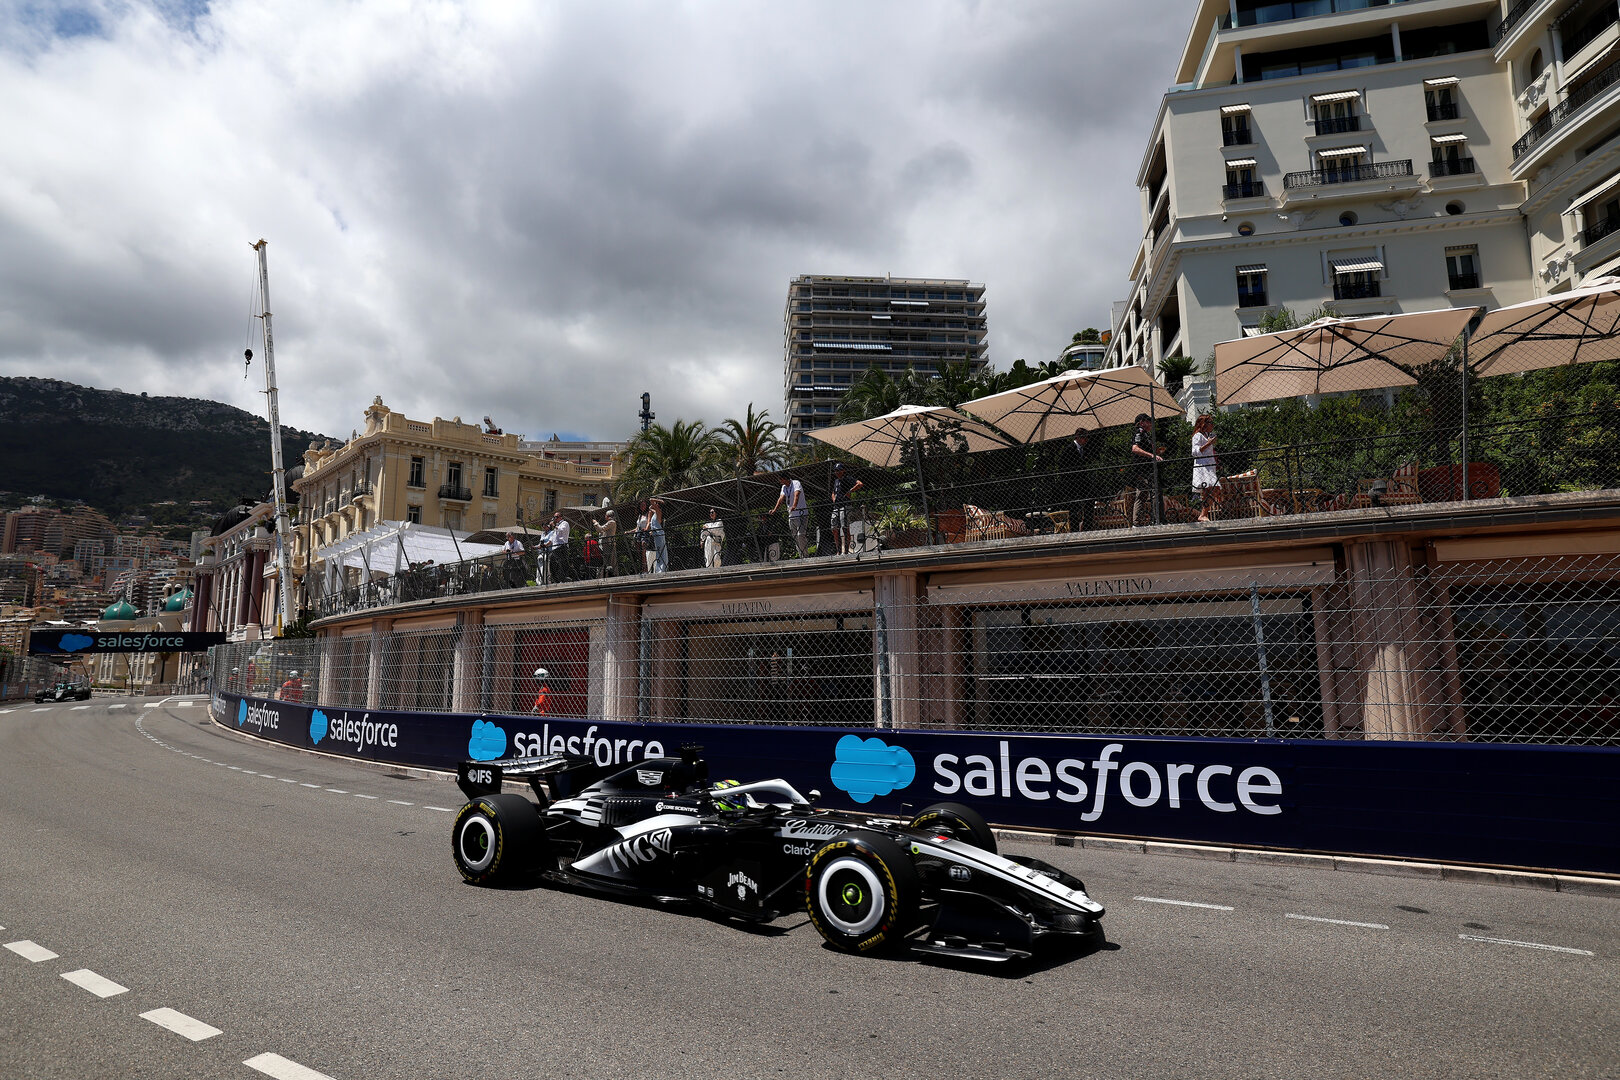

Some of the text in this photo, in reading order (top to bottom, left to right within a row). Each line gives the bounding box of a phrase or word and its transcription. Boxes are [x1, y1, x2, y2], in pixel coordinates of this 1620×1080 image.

[1066, 578, 1152, 595] VALENTINO
[722, 601, 772, 614] VALENTINO
[97, 634, 184, 651] salesforce
[247, 701, 280, 732] salesforce
[329, 711, 398, 753] salesforce
[513, 723, 665, 768] salesforce
[476, 769, 493, 784] IFS
[933, 740, 1283, 822] salesforce
[951, 868, 970, 880] FIA
